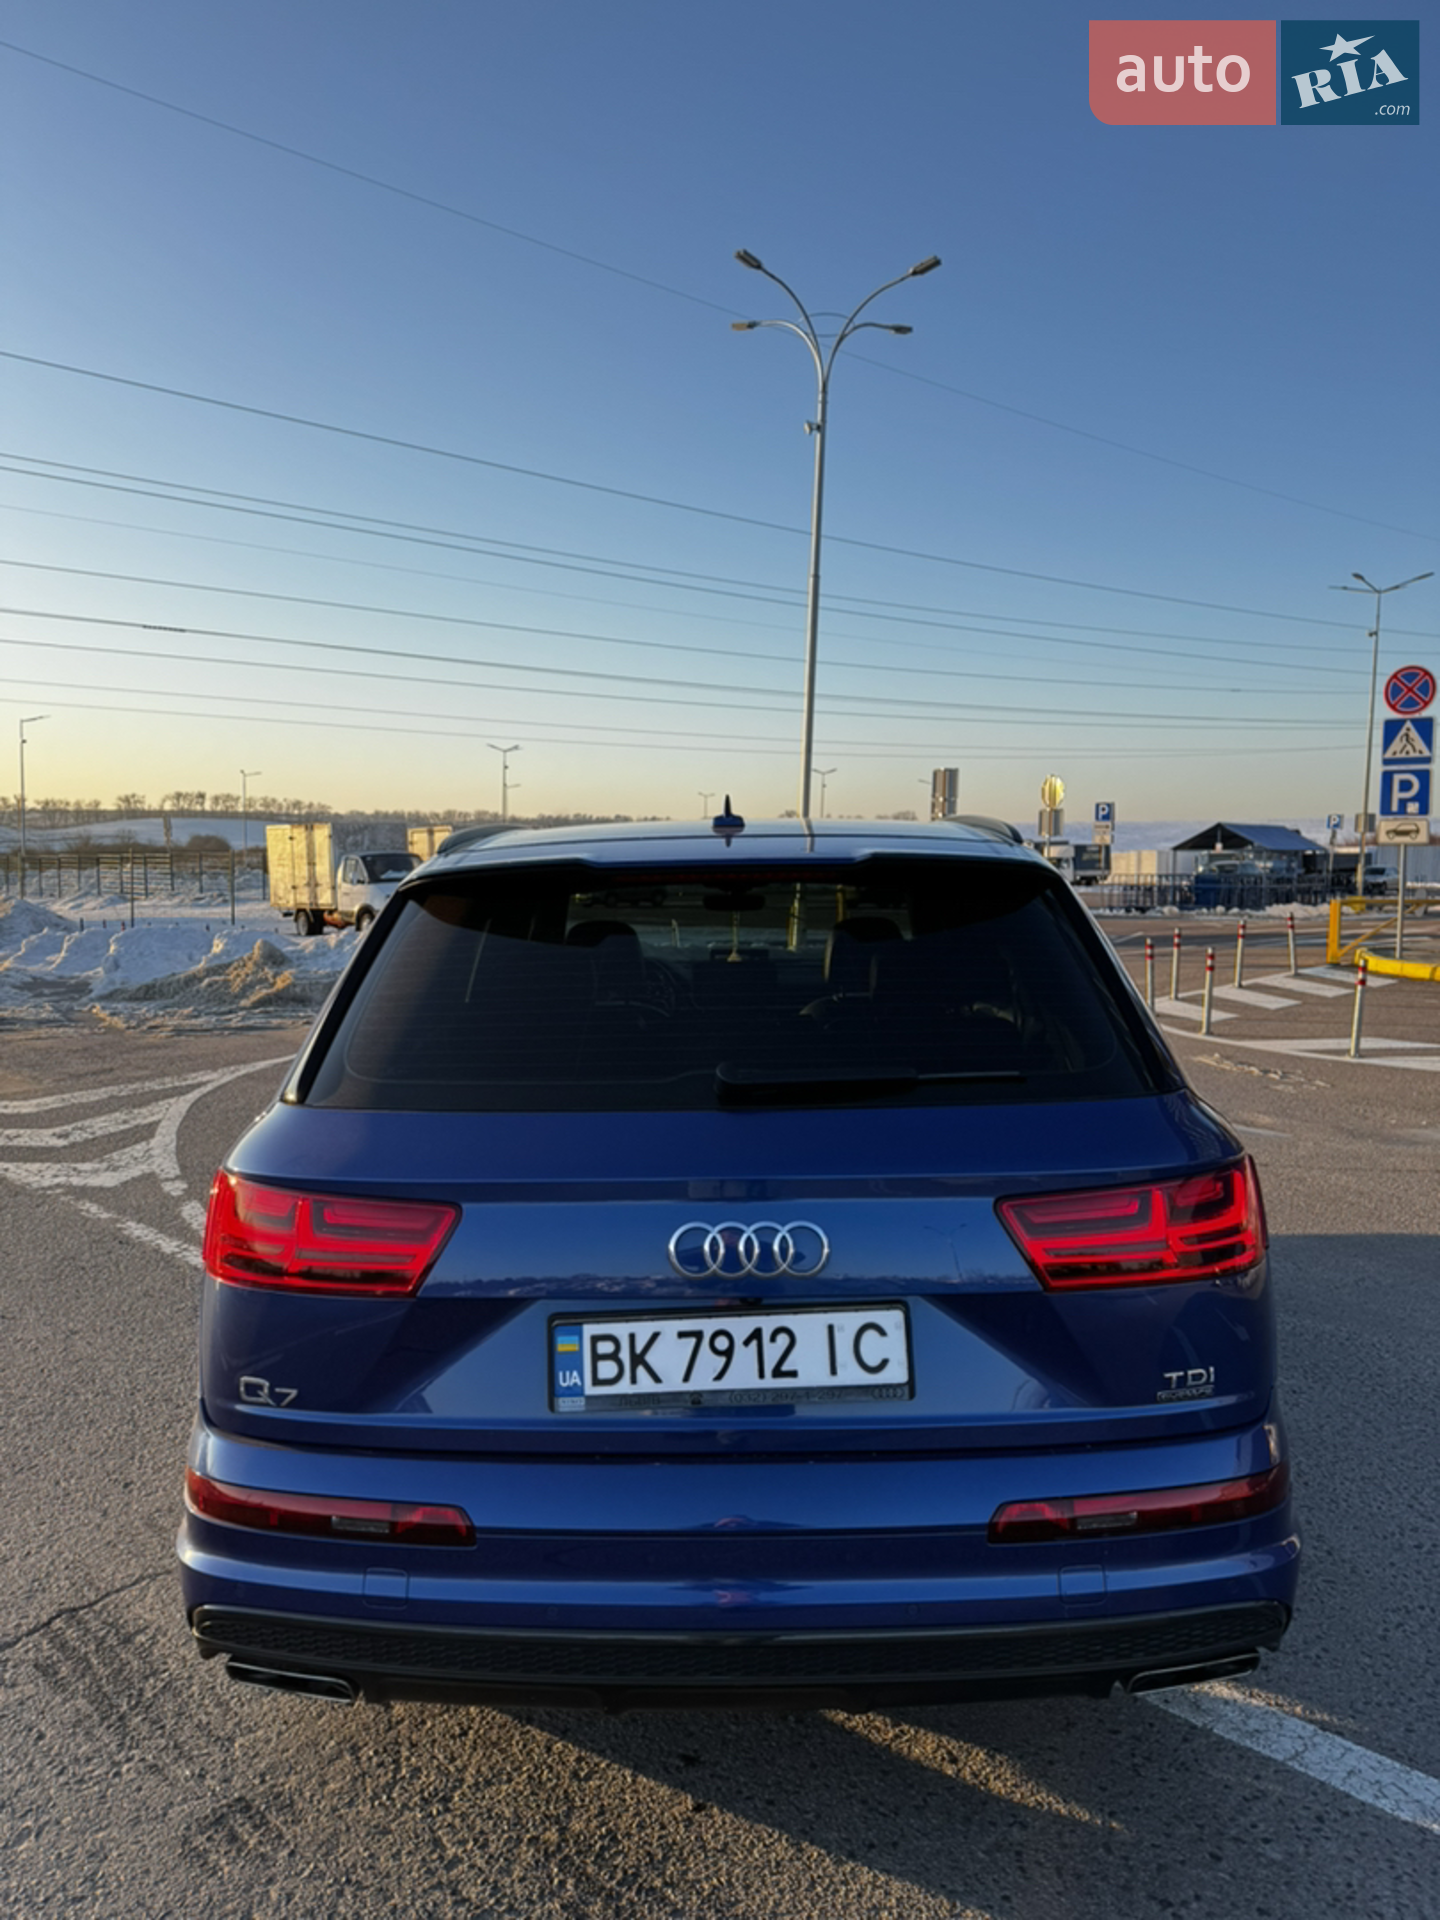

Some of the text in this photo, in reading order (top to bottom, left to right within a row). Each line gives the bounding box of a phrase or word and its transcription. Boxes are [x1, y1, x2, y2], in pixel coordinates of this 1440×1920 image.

[1391, 773, 1420, 812] P
[1098, 804, 1109, 820] P
[1330, 815, 1340, 828] P
[589, 1322, 890, 1387] BK 7912 IC
[559, 1370, 582, 1387] UA
[1163, 1366, 1215, 1389] TDI
[240, 1376, 298, 1406] Q7
